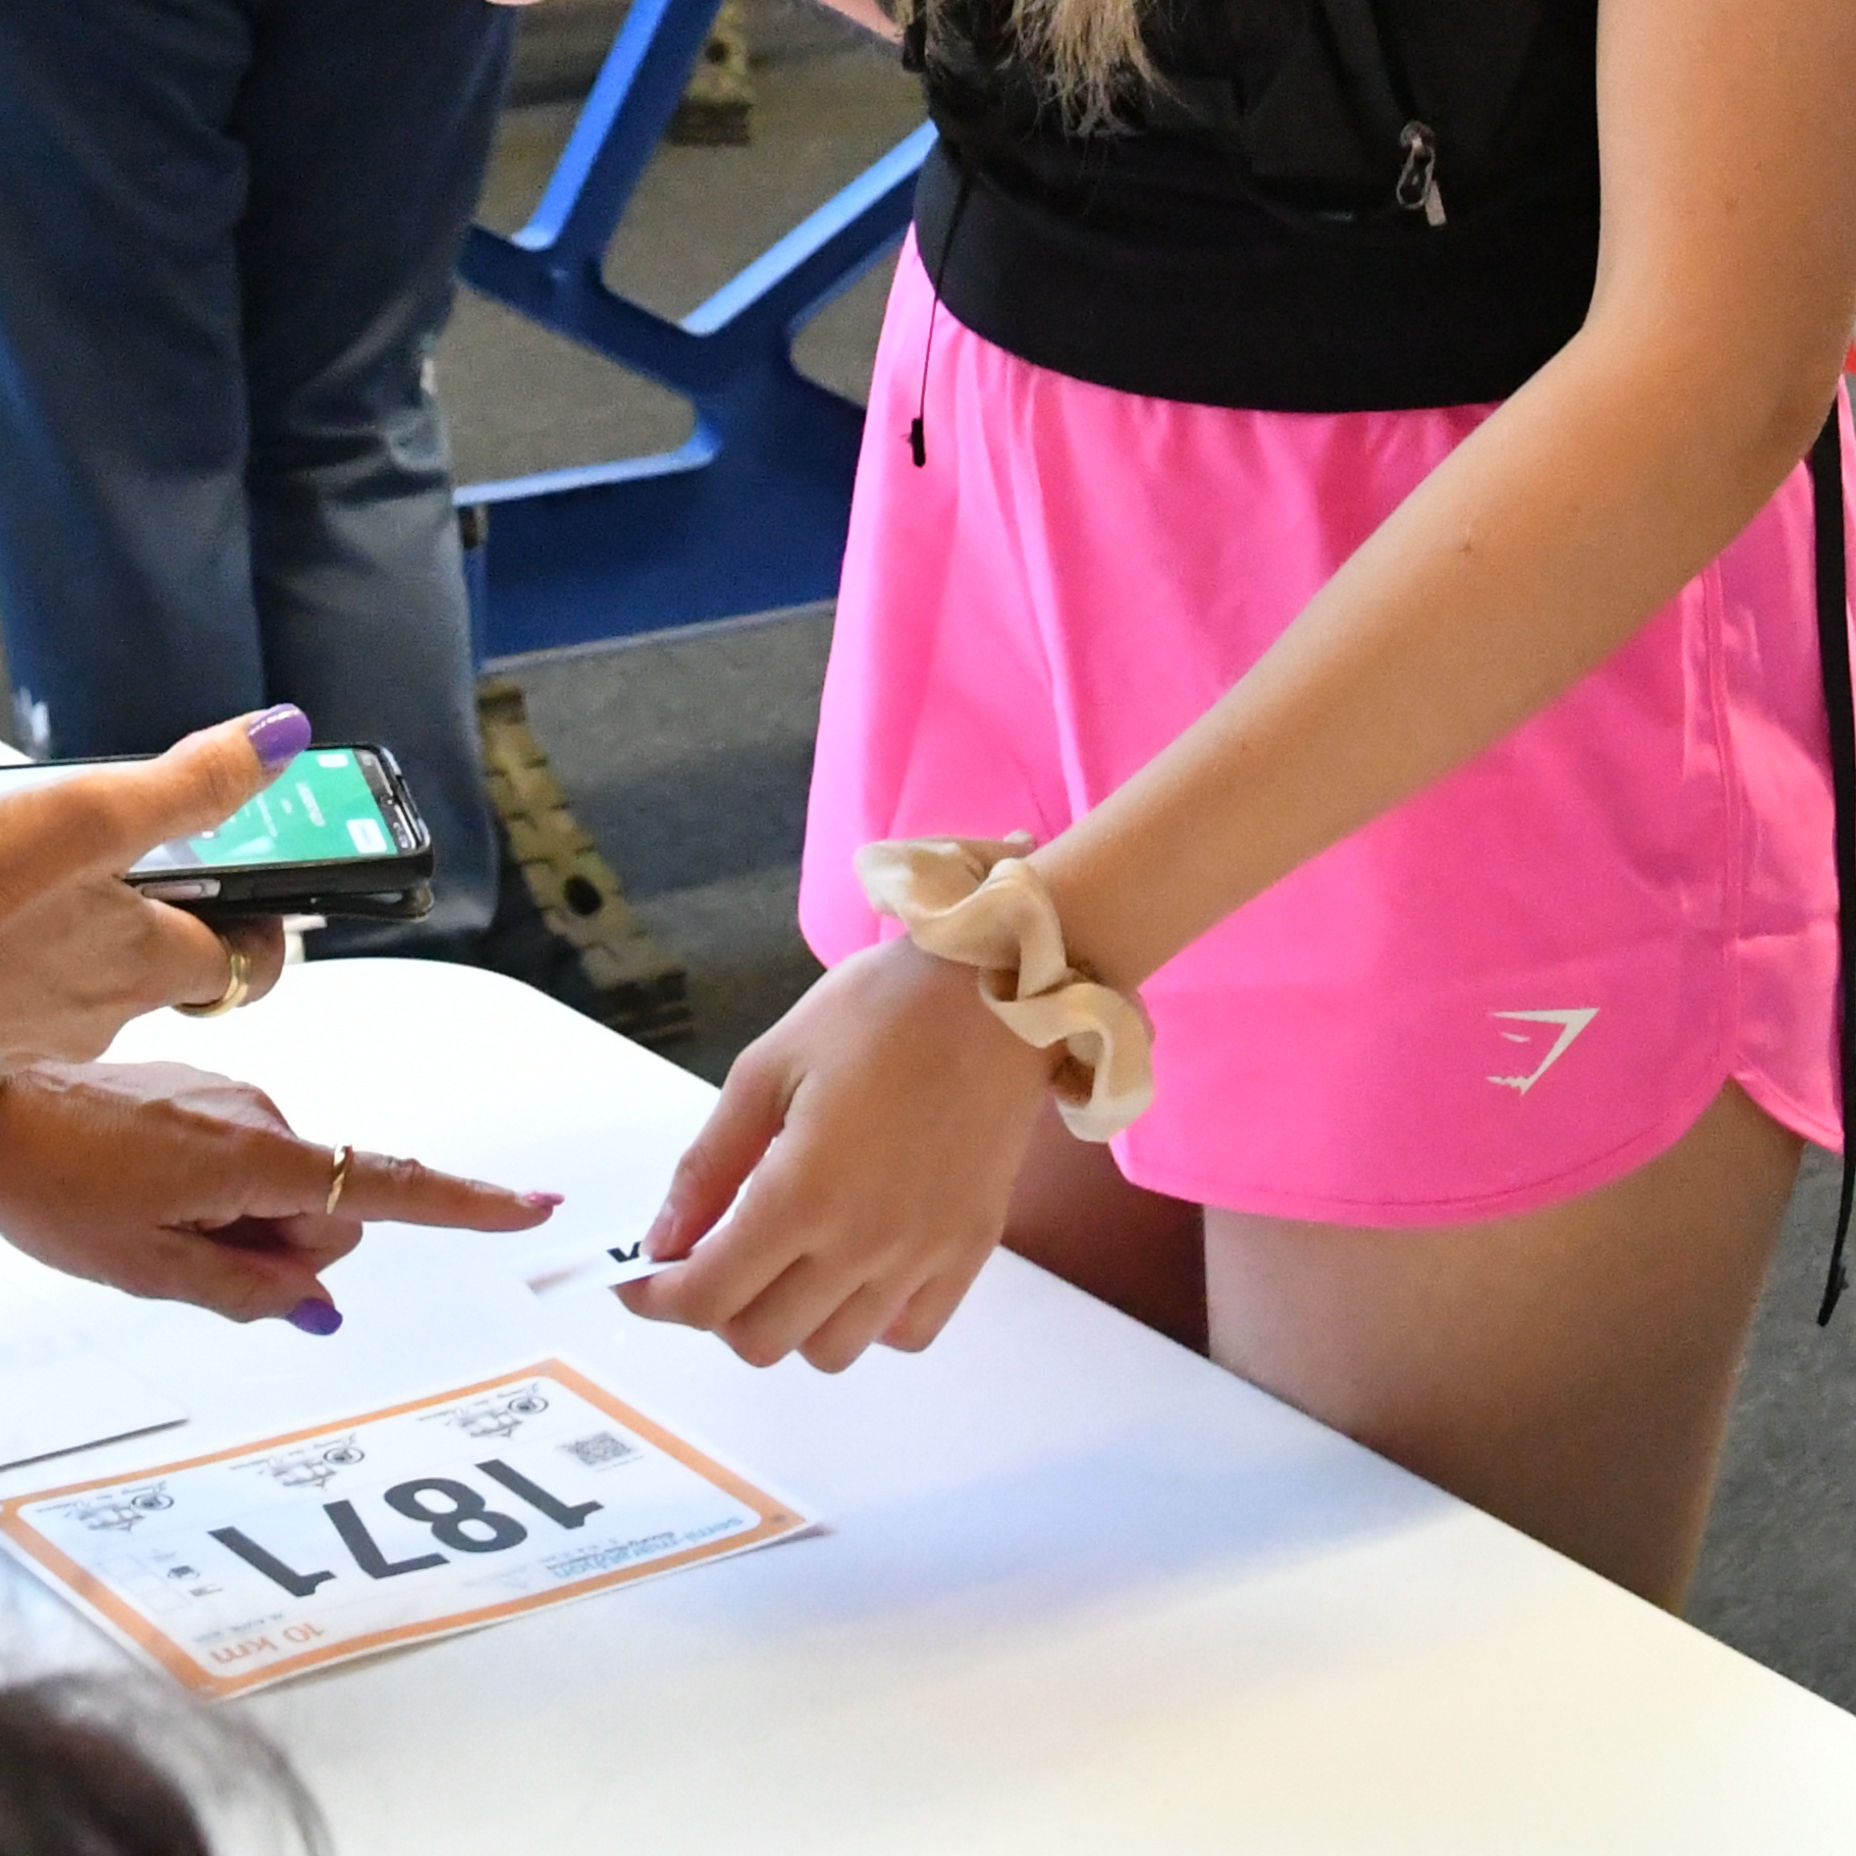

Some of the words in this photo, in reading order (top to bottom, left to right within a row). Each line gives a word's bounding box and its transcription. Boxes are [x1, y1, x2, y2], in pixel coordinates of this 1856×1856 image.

[208, 1458, 605, 1598] 1871
[283, 1622, 324, 1643] 10
[209, 1636, 279, 1663] km
